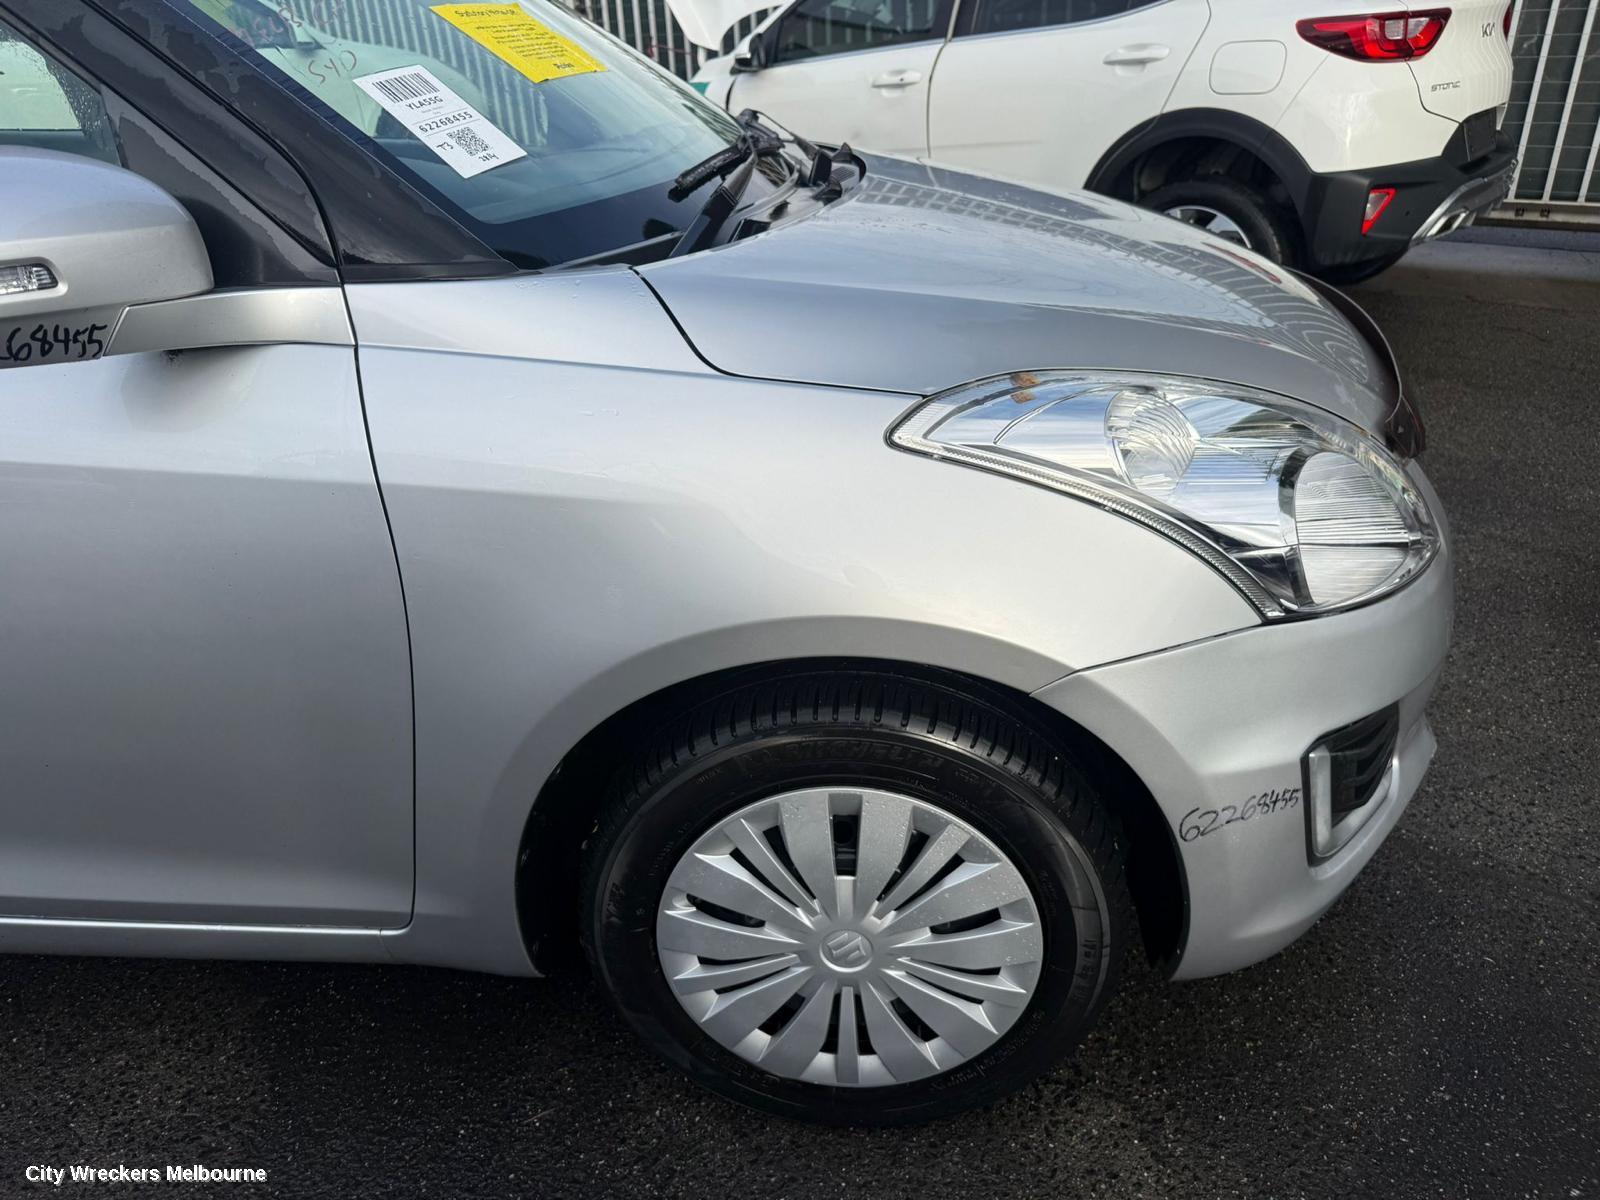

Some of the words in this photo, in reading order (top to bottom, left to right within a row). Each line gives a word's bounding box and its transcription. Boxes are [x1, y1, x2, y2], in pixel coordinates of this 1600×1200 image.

[308, 50, 357, 87] SYD
[418, 111, 474, 133] 62268455
[0, 323, 108, 361] 68455
[1179, 788, 1302, 842] 62268455
